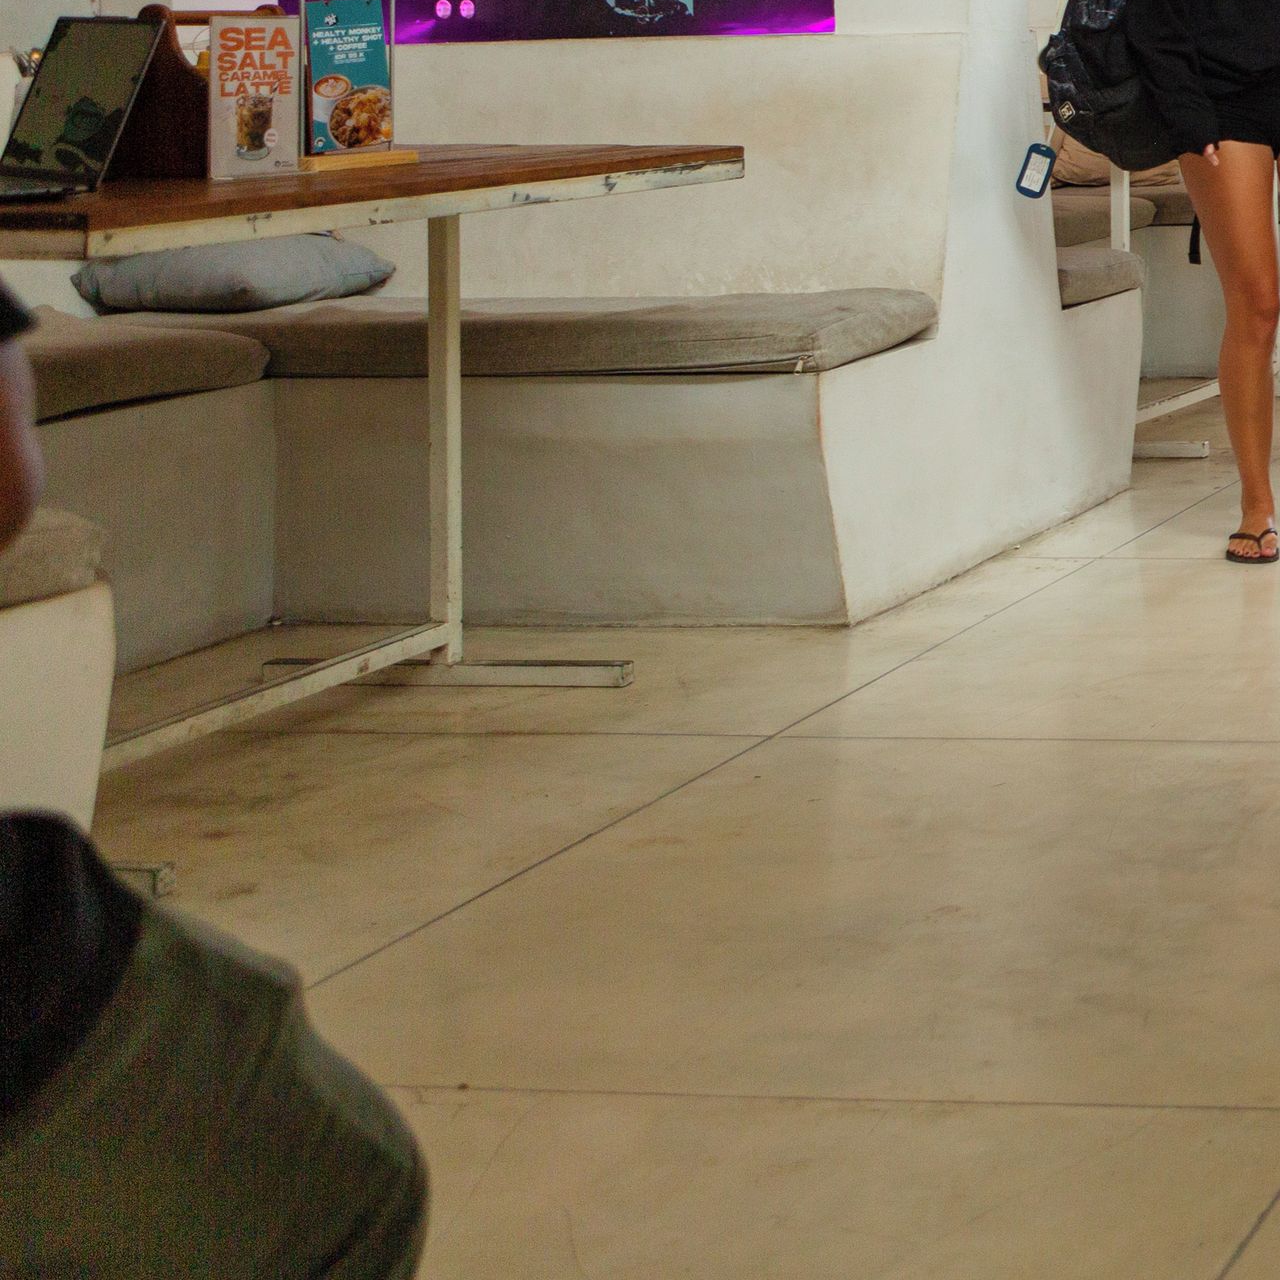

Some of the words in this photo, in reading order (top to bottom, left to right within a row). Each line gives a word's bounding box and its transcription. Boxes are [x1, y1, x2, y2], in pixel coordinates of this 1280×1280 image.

[218, 26, 292, 52] SEA
[312, 29, 346, 39] HEALTY
[347, 25, 382, 35] MONKEY
[321, 34, 360, 45] HEALTHY
[361, 32, 383, 42] SHOT
[336, 41, 368, 51] COFFEE
[217, 51, 295, 71] SALT
[218, 71, 294, 82] CARAMEL
[220, 80, 292, 97] LATTE
